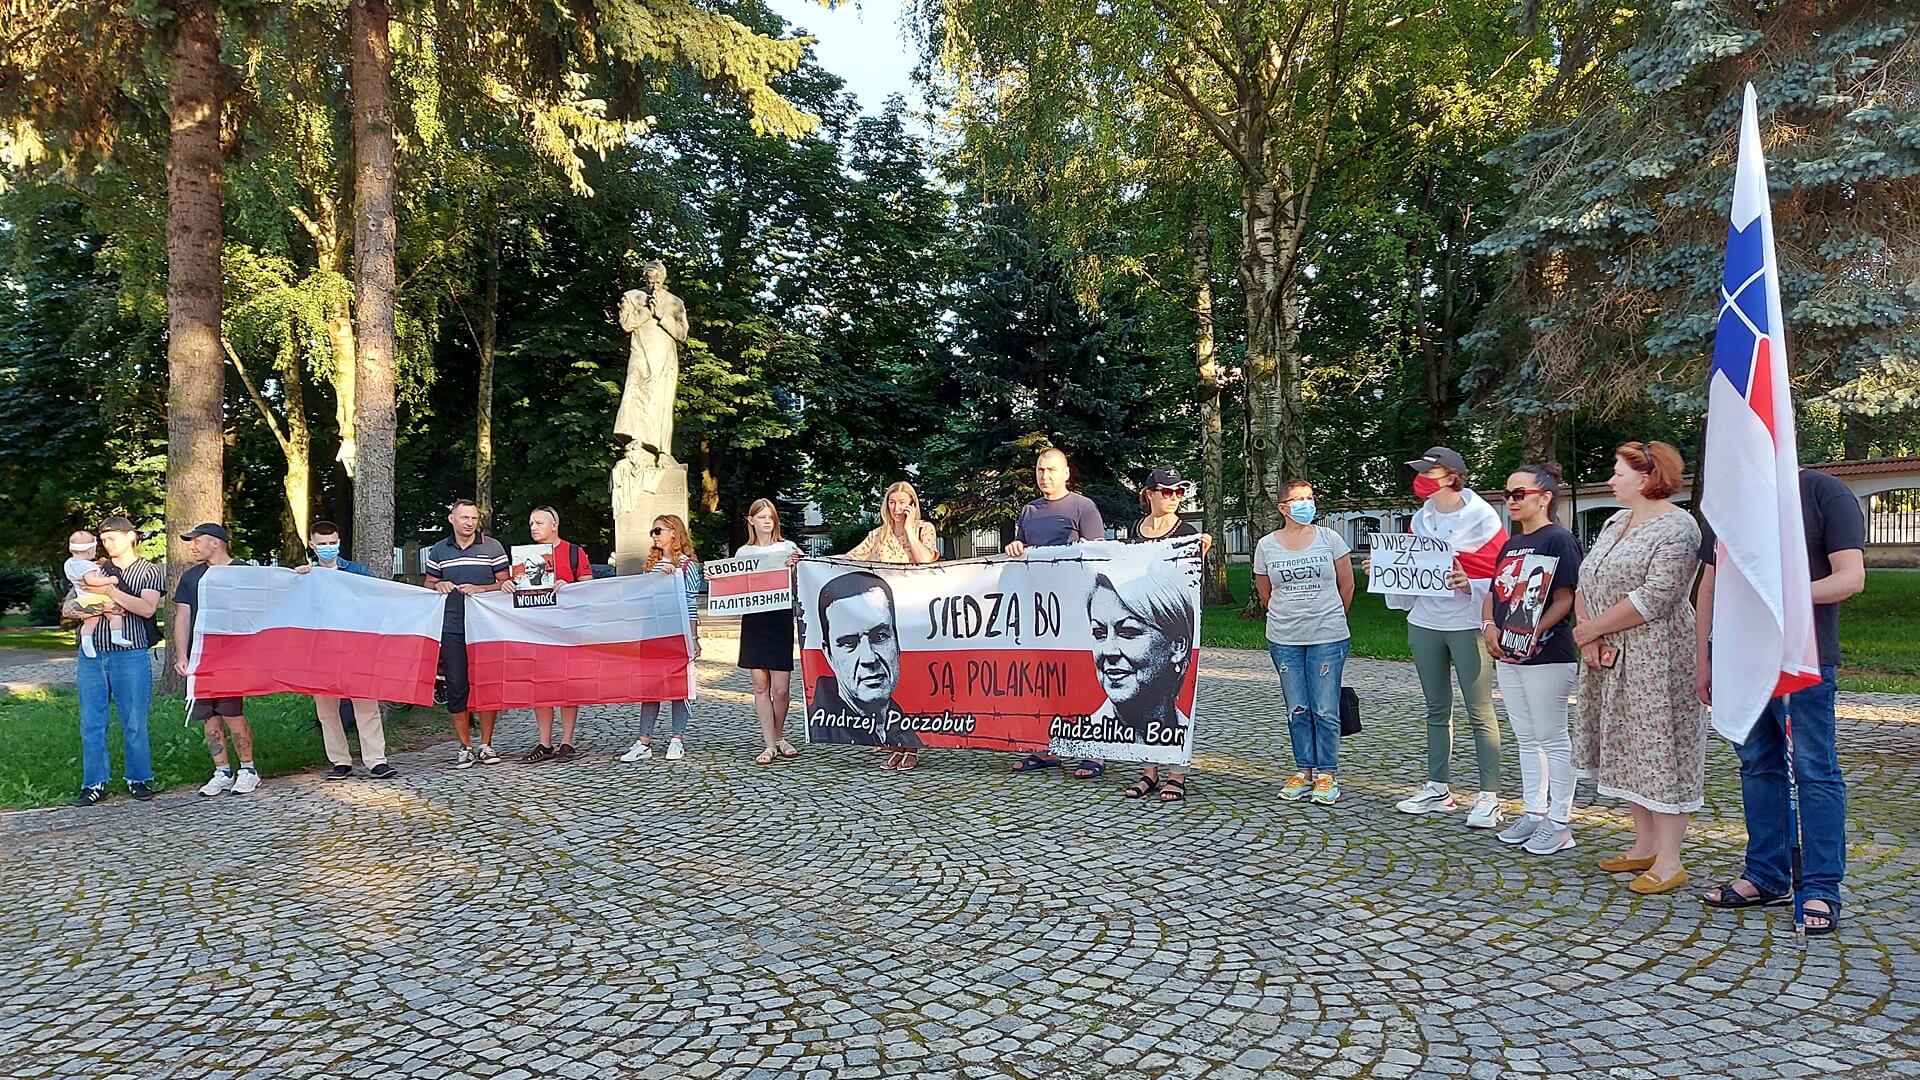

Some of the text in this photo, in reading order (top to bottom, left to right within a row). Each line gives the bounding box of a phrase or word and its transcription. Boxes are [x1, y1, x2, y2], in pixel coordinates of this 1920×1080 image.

[708, 559, 760, 575] СВОБОДУ
[1271, 555, 1328, 569] METROPOLITAN
[1393, 551, 1416, 565] ZA
[710, 592, 790, 610] ПАЛІТВЯЗНЯМ
[926, 591, 1061, 645] SIEDZĄ BO
[928, 661, 1067, 702] SĄ POLAKAMI
[810, 708, 976, 734] Andrzej Poczobut
[1050, 716, 1135, 741] Andżelika
